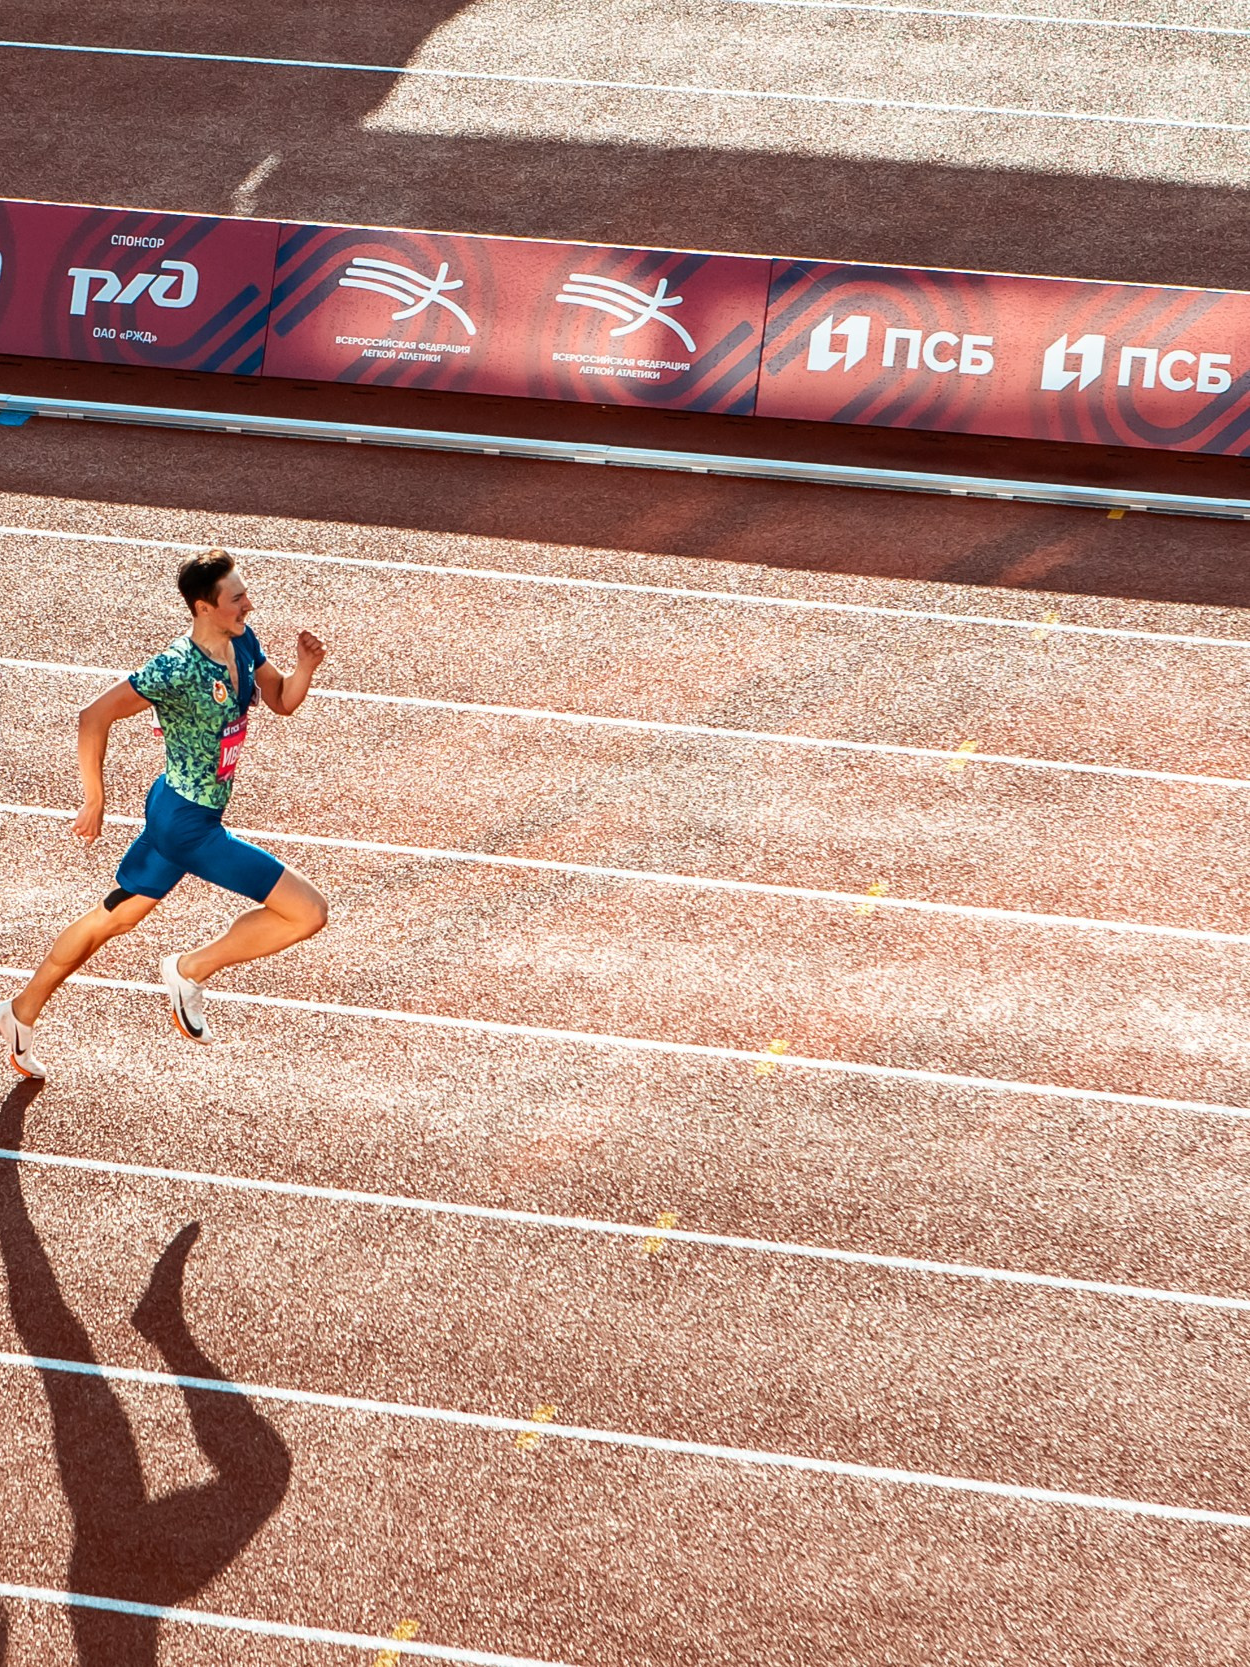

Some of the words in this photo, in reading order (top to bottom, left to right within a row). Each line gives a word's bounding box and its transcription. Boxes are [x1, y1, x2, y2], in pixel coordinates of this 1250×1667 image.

[111, 234, 165, 249] СПОНСОР
[93, 327, 117, 340] ОАО
[119, 330, 158, 344] «РЖД»
[335, 336, 416, 350] ВСЕРОССИЙСКАЯ
[418, 342, 471, 354] ФЕДЕРАЦИЯ
[881, 327, 994, 375] ПСБ
[361, 349, 396, 359] ЛЕГКОЙ
[397, 352, 442, 363] АТЛЕТИКИ
[552, 352, 635, 367] ВСЕРОССИЙСКАЯ
[636, 359, 690, 371] ФЕДЕРАЦИЯ
[579, 366, 614, 376] ЛЕГКОЙ
[616, 368, 661, 380] АТЛЕТИКИ
[1118, 346, 1232, 394] ПСБ
